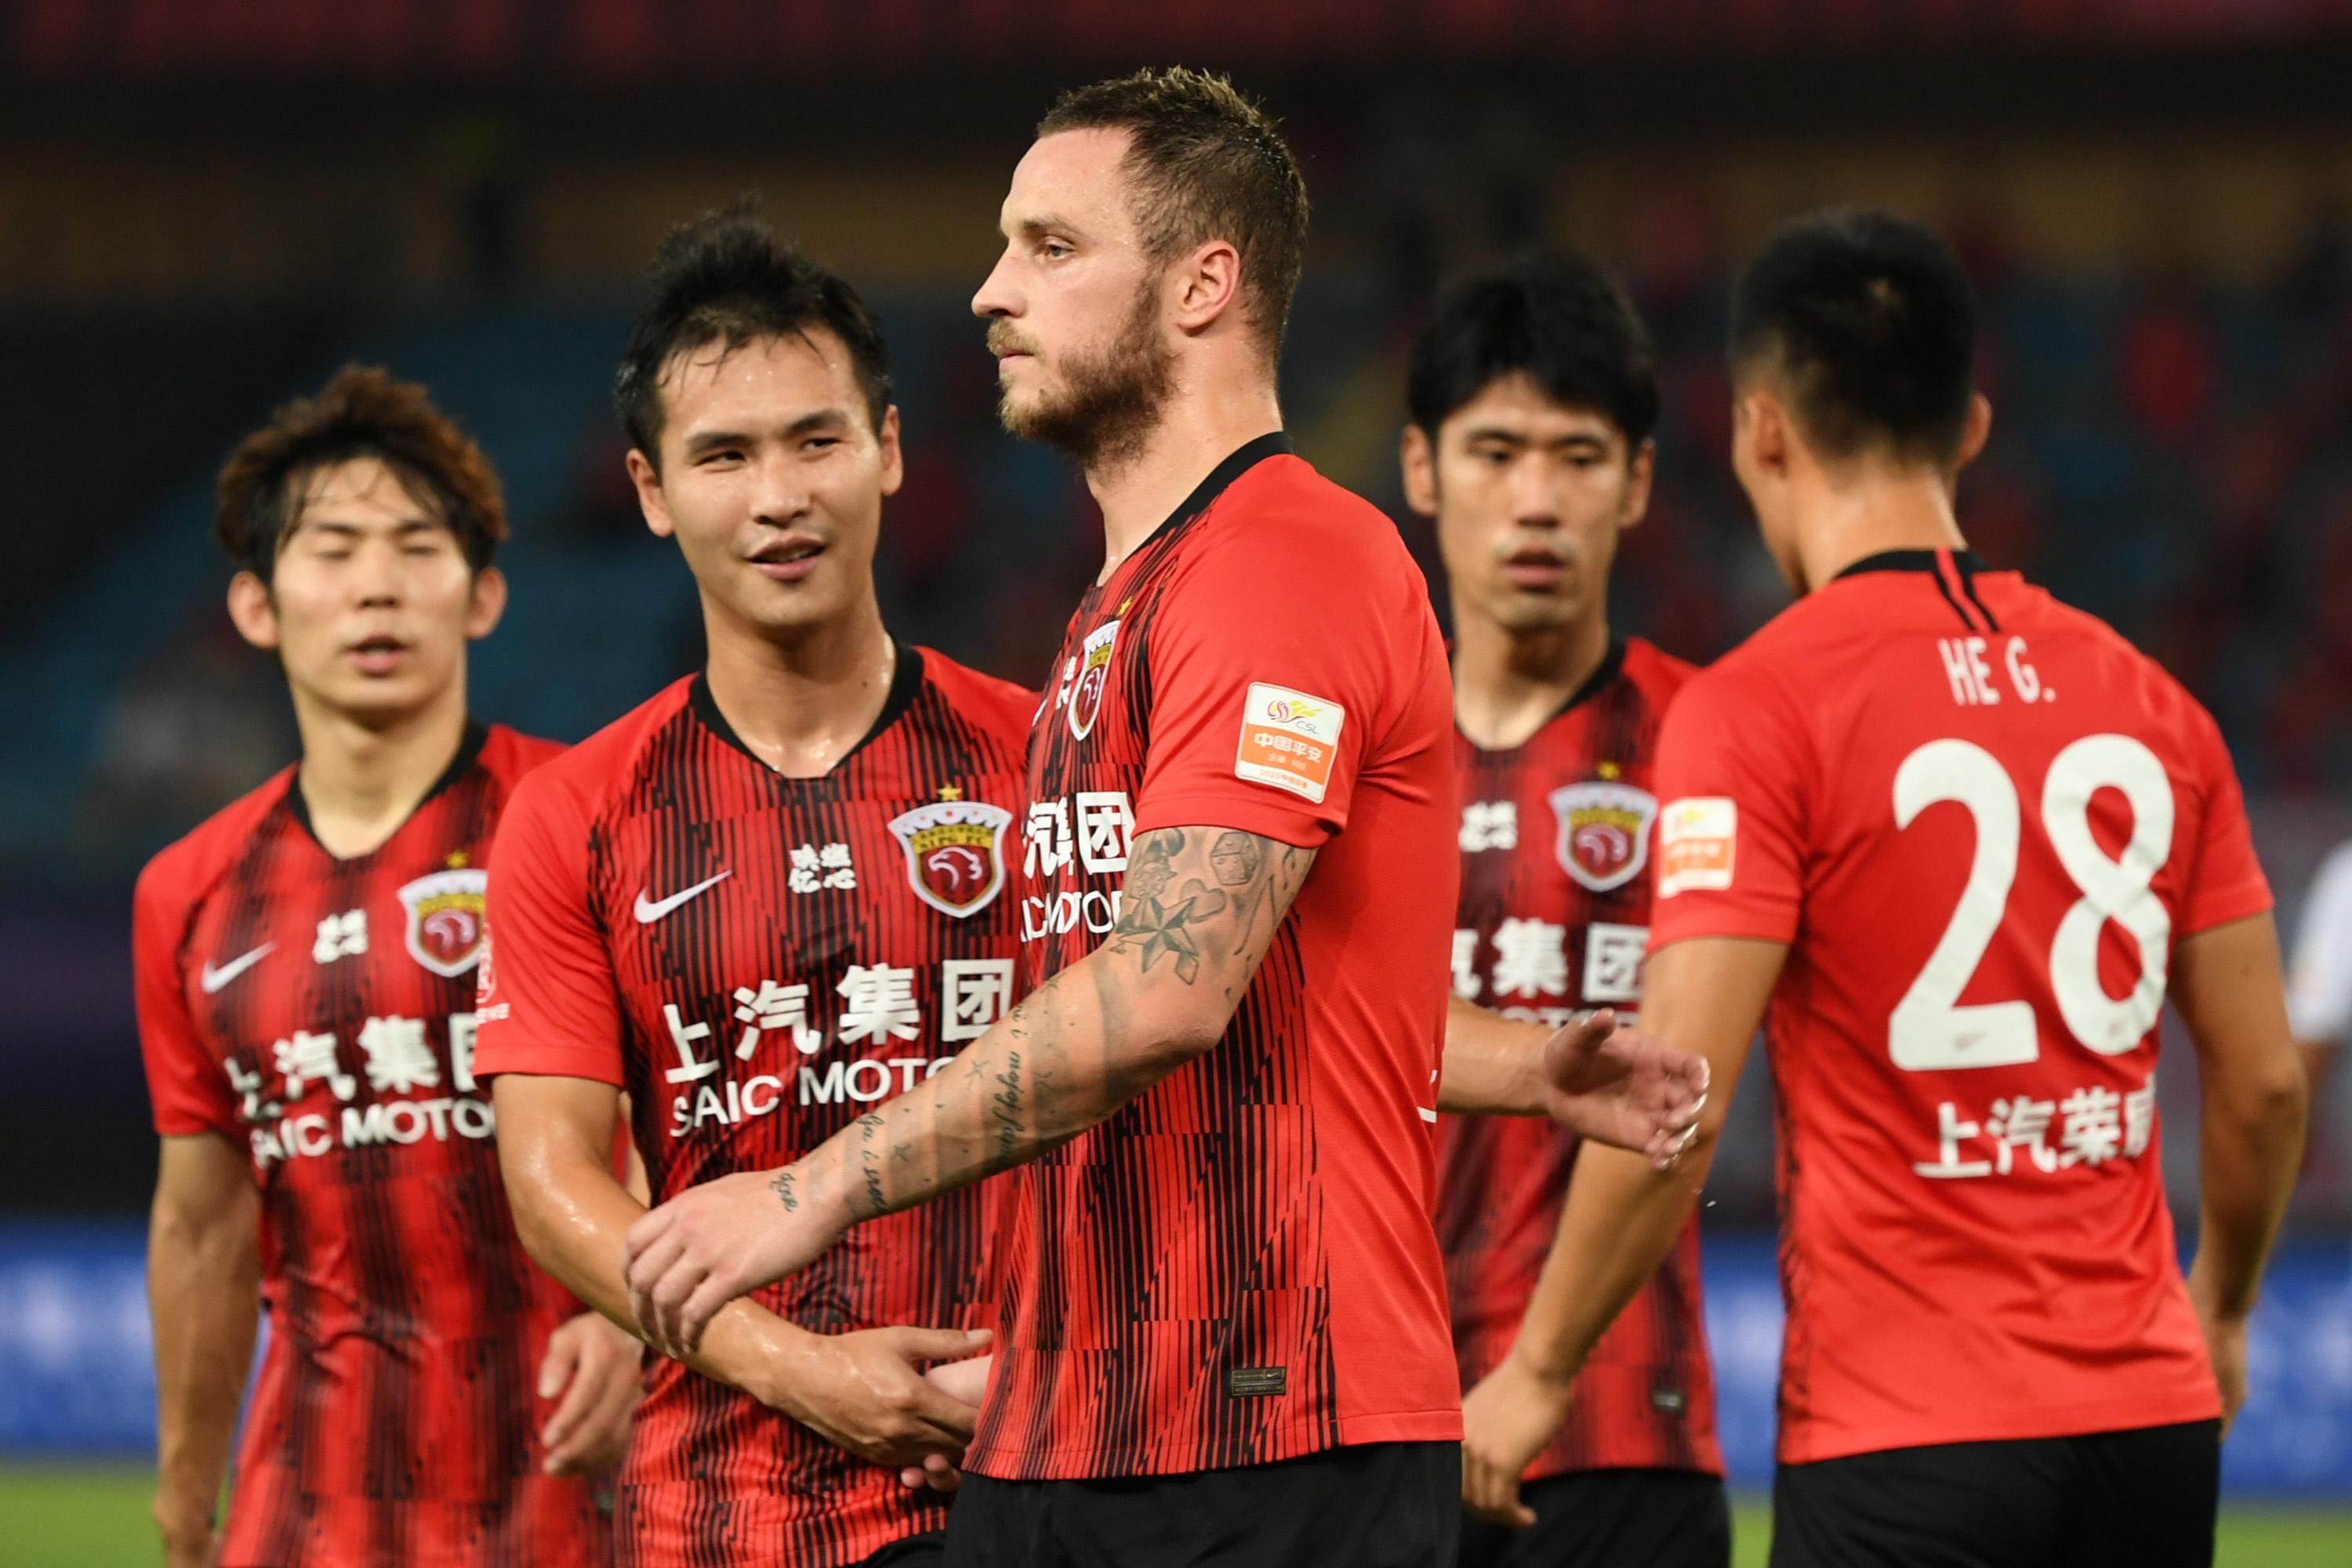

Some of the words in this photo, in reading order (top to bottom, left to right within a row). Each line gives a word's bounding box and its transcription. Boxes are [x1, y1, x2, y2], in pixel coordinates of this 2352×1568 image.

[1938, 636, 2001, 706] HE
[2005, 635, 2057, 703] G.
[1255, 733, 1322, 763] 中国平安
[1296, 721, 1318, 734] CSL
[1889, 733, 2175, 1071] 28
[664, 959, 1014, 1085] 上汽集团
[341, 1097, 497, 1149] MOTO
[670, 1075, 782, 1138] SAIC
[798, 1056, 955, 1106] MOT
